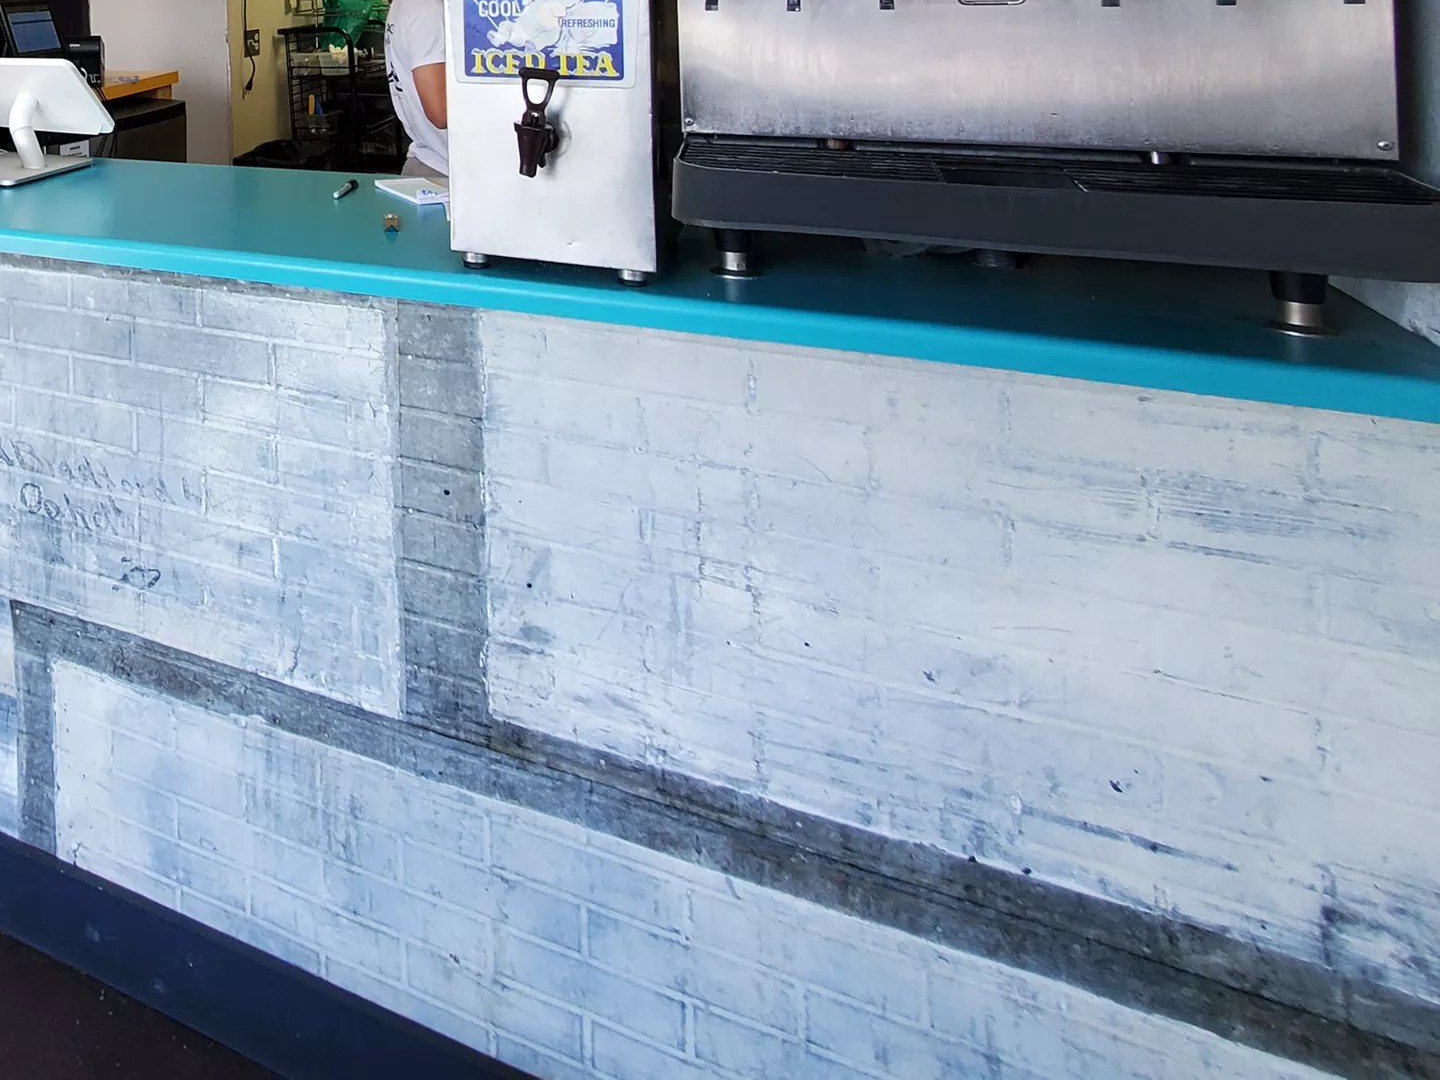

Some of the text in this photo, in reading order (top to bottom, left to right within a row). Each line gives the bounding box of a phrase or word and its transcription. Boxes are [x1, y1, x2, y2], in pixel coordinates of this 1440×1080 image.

[478, 0, 521, 18] COOL
[561, 18, 616, 28] REFRESHING
[472, 49, 620, 77] ICED TEA
